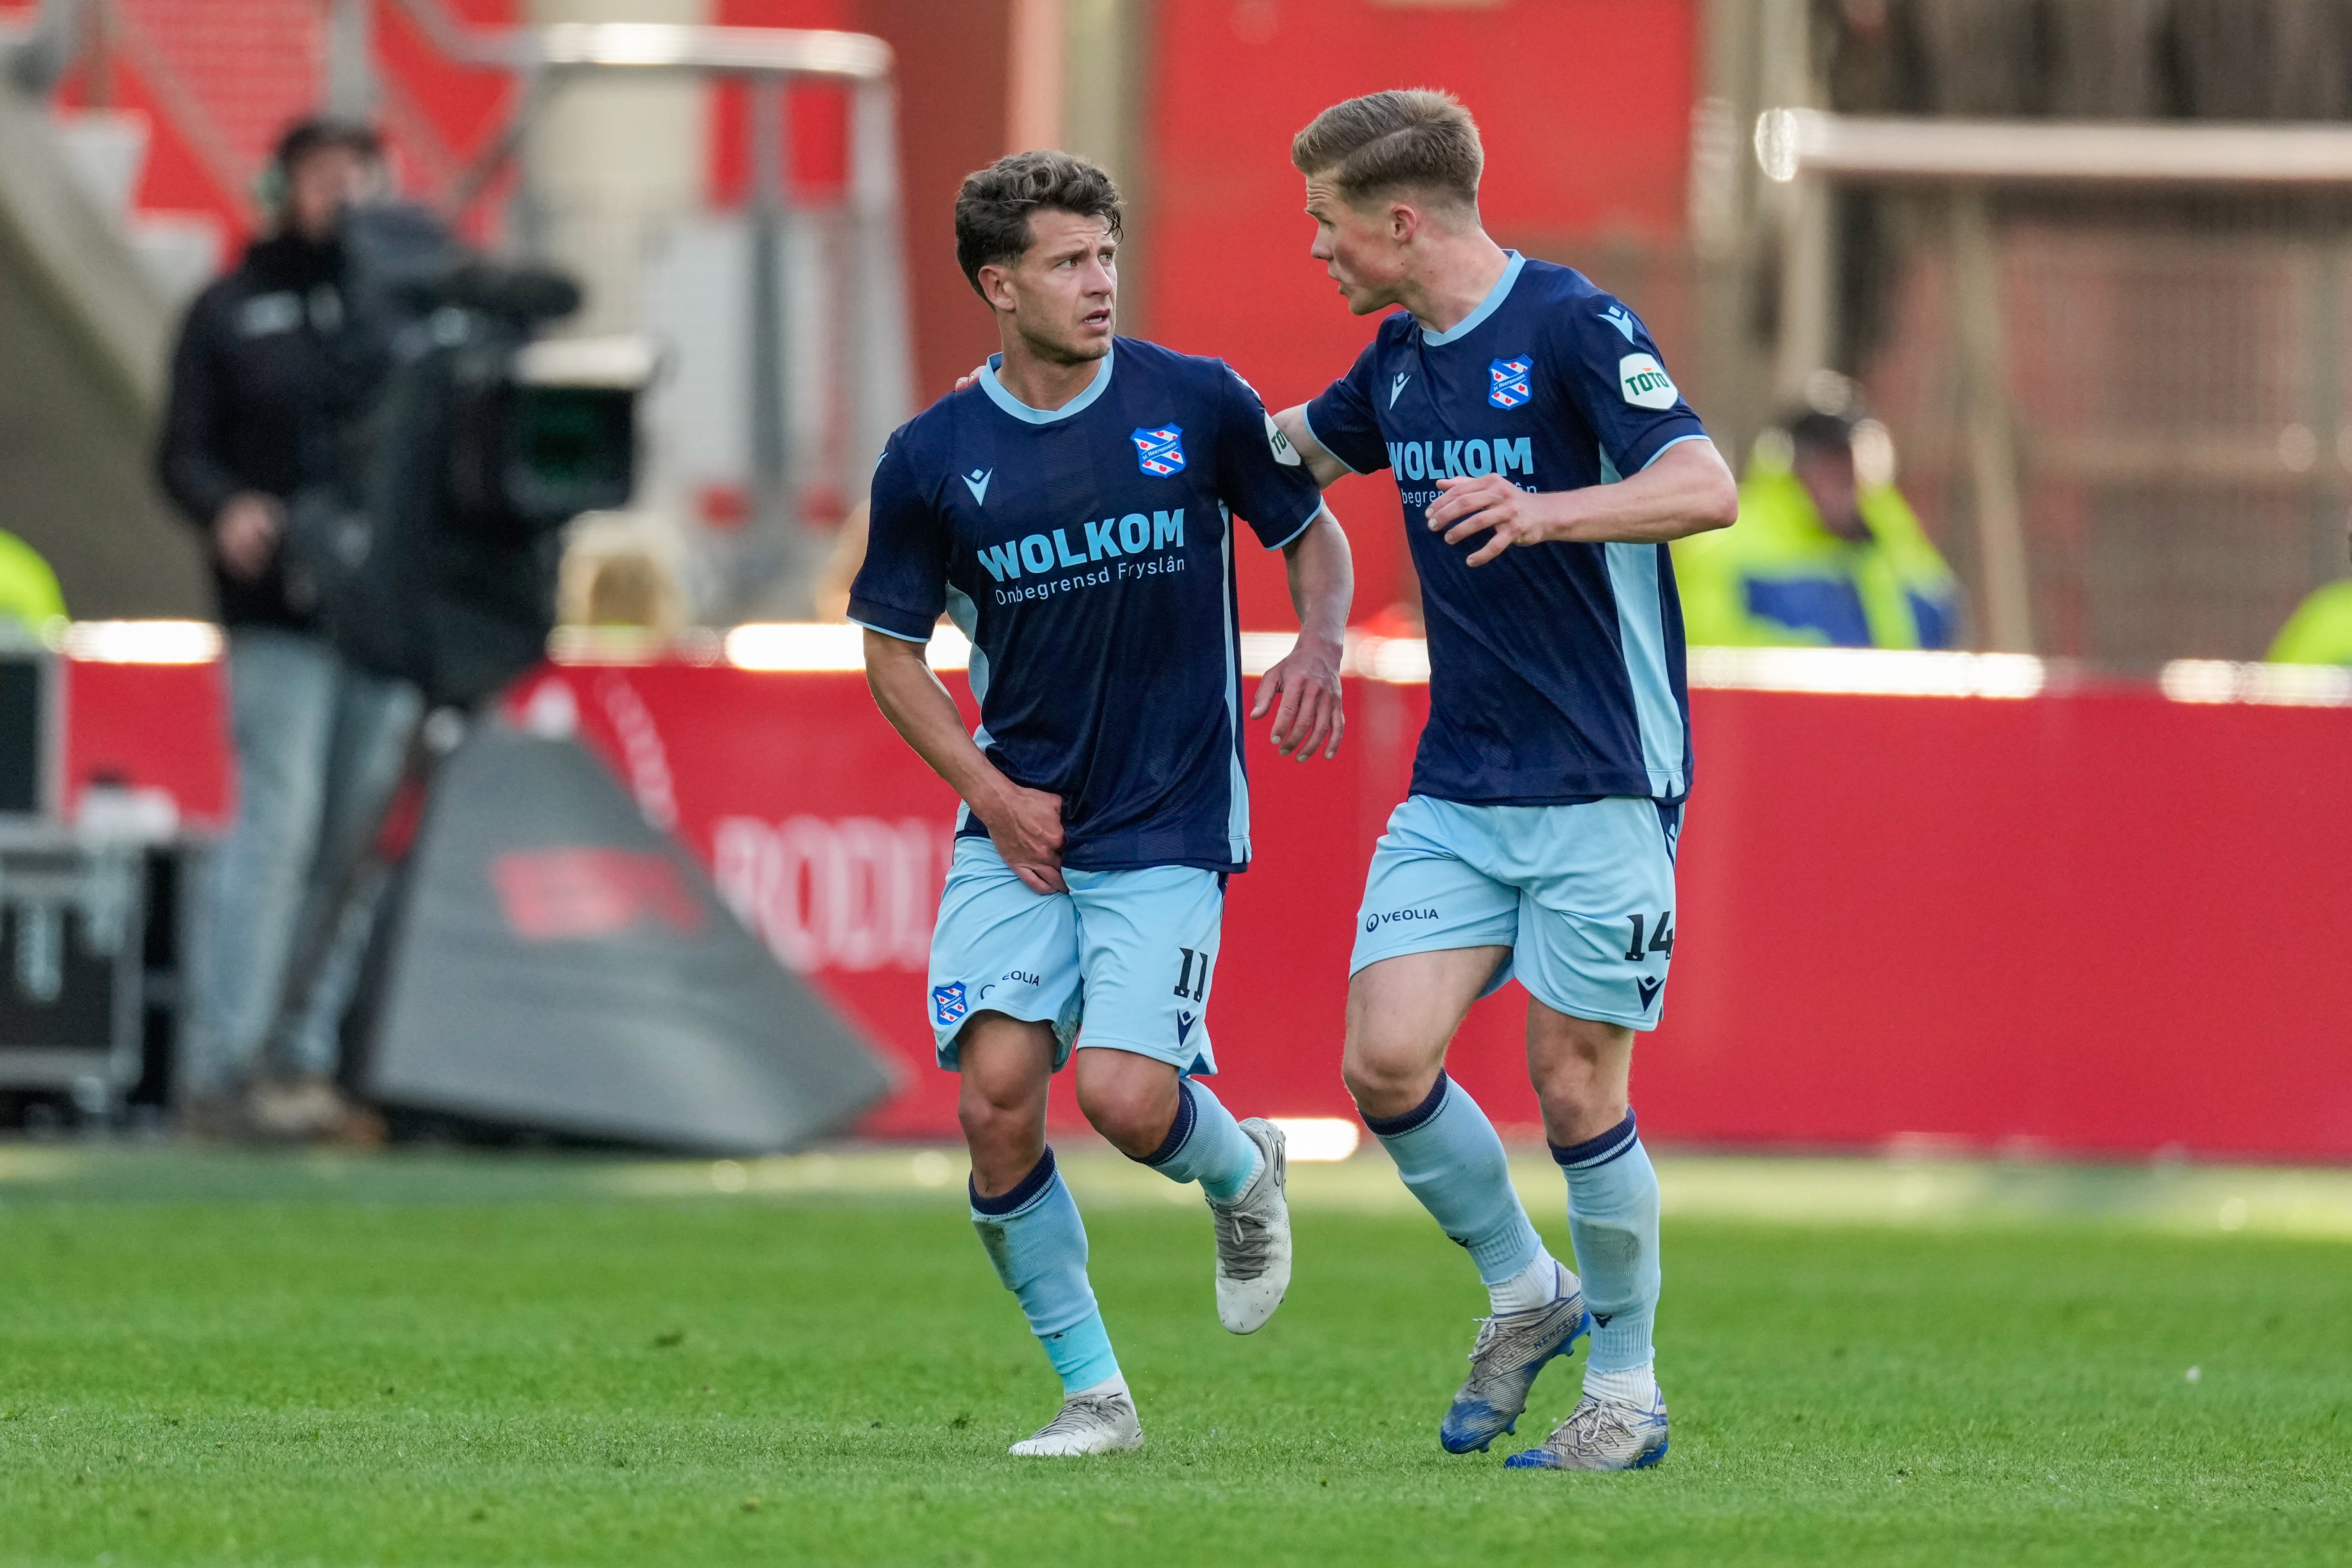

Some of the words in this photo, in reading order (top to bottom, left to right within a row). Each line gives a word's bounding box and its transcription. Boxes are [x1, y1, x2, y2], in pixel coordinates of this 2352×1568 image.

[1499, 374, 1525, 388] Heerenveen
[1625, 372, 1670, 396] TOTO
[1148, 442, 1176, 457] Heerenveen
[1271, 430, 1287, 455] TO
[1386, 437, 1534, 481] WOLKOM
[977, 508, 1185, 582] WOLKOM
[996, 567, 1110, 605] Onbegrensd
[1118, 556, 1185, 579] Fryslân
[1381, 909, 1439, 923] VEOLIA
[1624, 911, 1675, 961] 14
[1002, 971, 1040, 987] EOLIA
[1173, 947, 1208, 1003] 11
